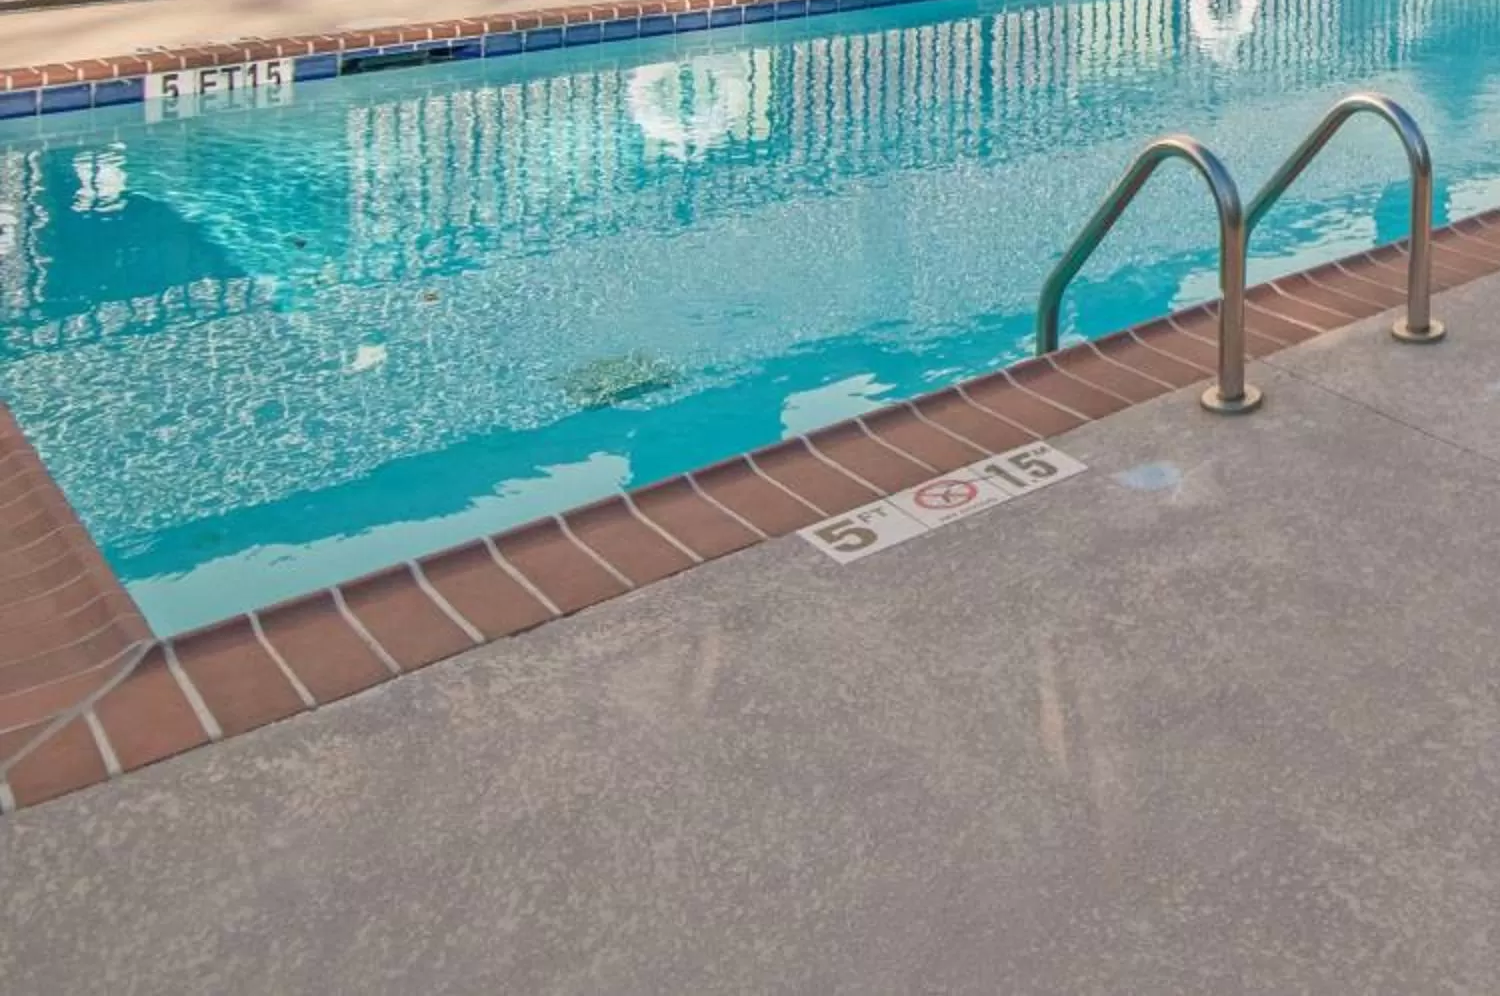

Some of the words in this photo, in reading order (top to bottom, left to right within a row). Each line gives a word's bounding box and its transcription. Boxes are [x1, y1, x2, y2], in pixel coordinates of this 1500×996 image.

[162, 73, 179, 97] 5
[200, 66, 241, 94] FT
[813, 518, 878, 552] 5
[856, 506, 888, 524] FT
